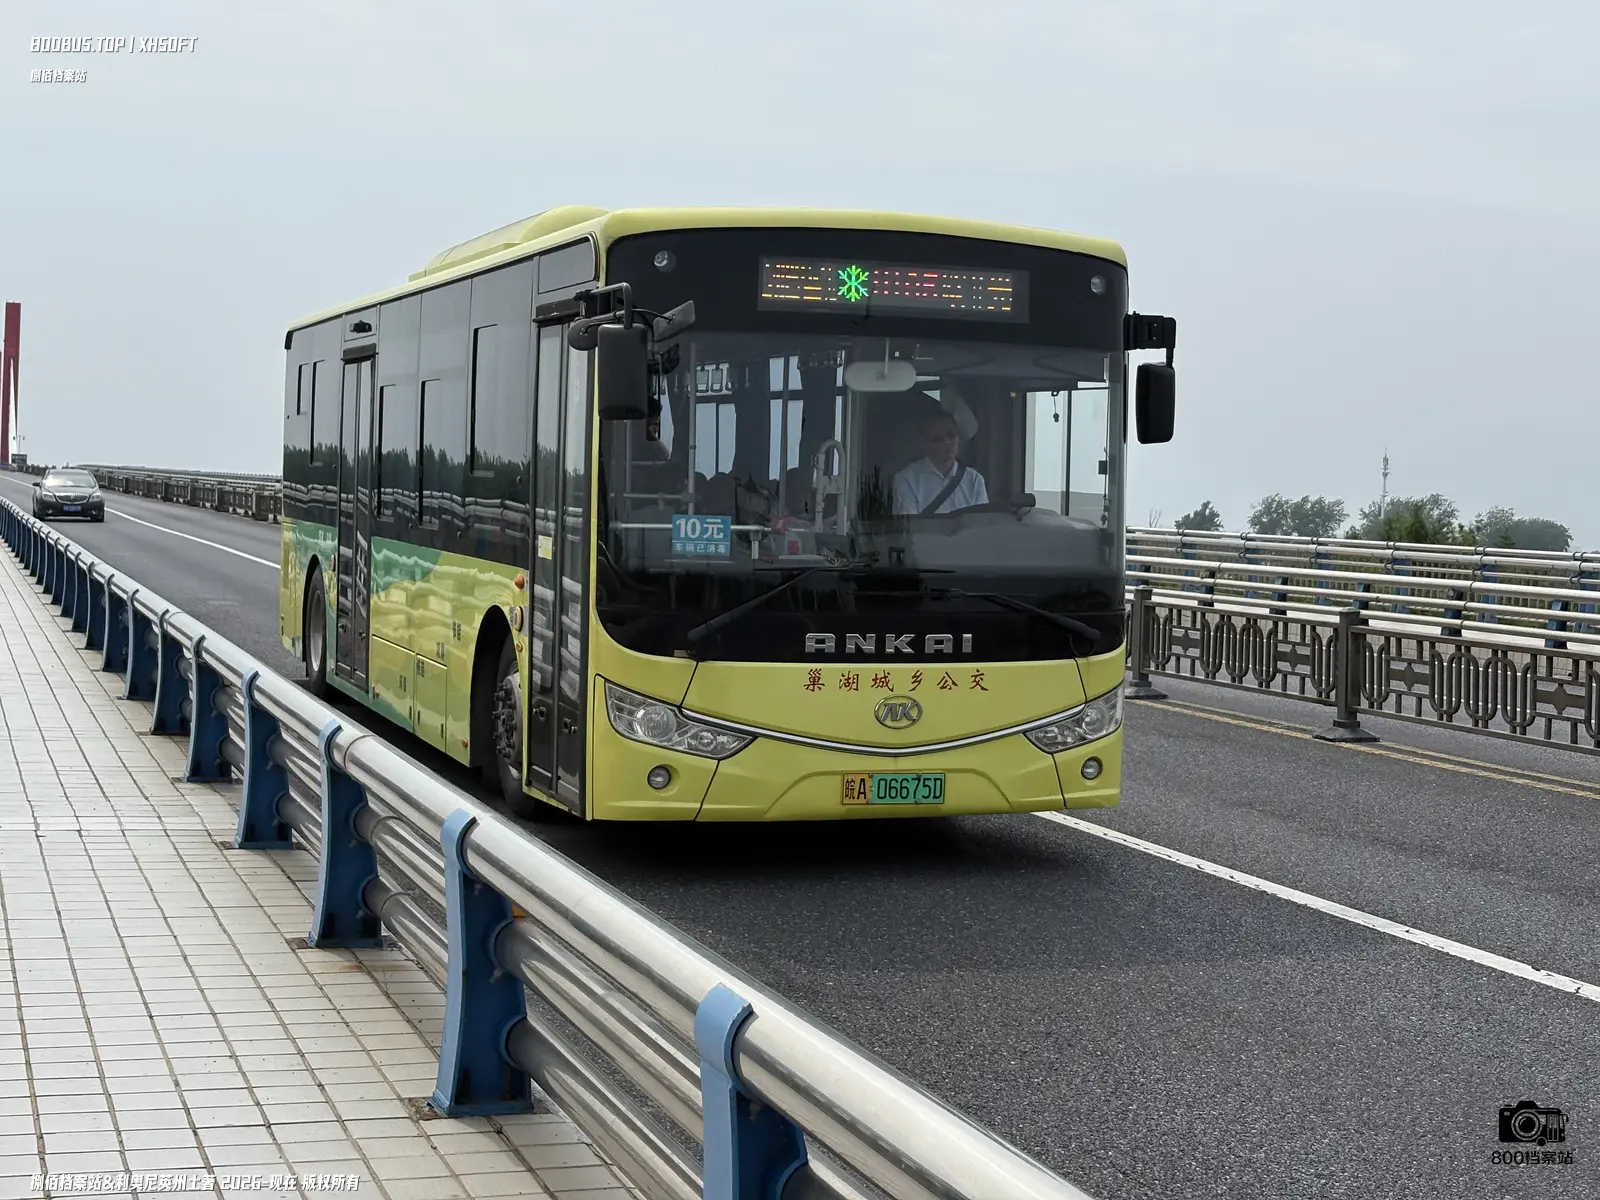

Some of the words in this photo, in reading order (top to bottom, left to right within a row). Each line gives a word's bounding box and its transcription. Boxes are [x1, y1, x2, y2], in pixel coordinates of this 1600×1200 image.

[676, 518, 725, 539] 10元
[675, 542, 727, 554] 车辆已消毒
[804, 632, 973, 654] ANKAI
[803, 668, 989, 692] 巢湖城乡公交
